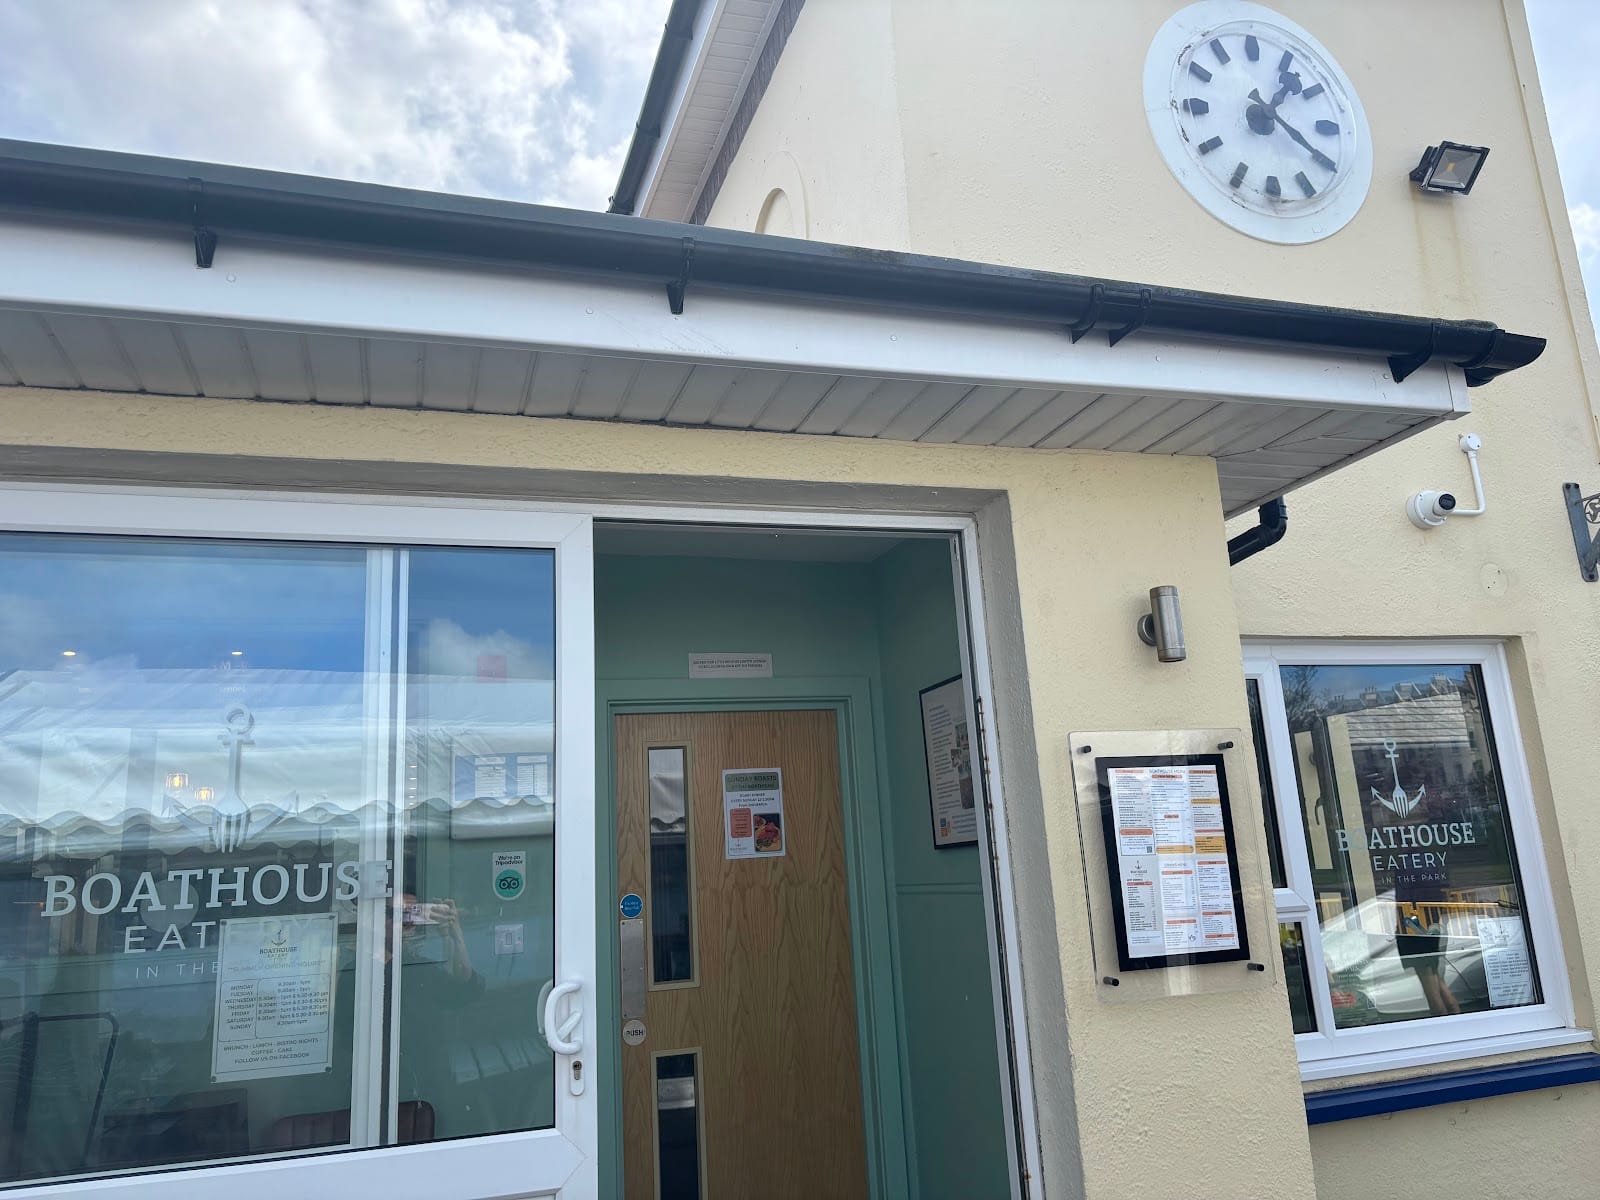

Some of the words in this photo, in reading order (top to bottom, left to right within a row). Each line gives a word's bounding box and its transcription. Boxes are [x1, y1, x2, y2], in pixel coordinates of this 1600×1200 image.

[1335, 822, 1475, 852] BOATHOUSE
[1372, 852, 1447, 871] EATERY
[1421, 872, 1447, 881] PARK
[40, 859, 393, 918] BOATHOUSE
[123, 921, 217, 954] EAT
[259, 946, 298, 954] BOATHOUSE
[135, 966, 159, 980] IN
[176, 961, 219, 976] THE
[626, 1029, 644, 1037] PUSH
